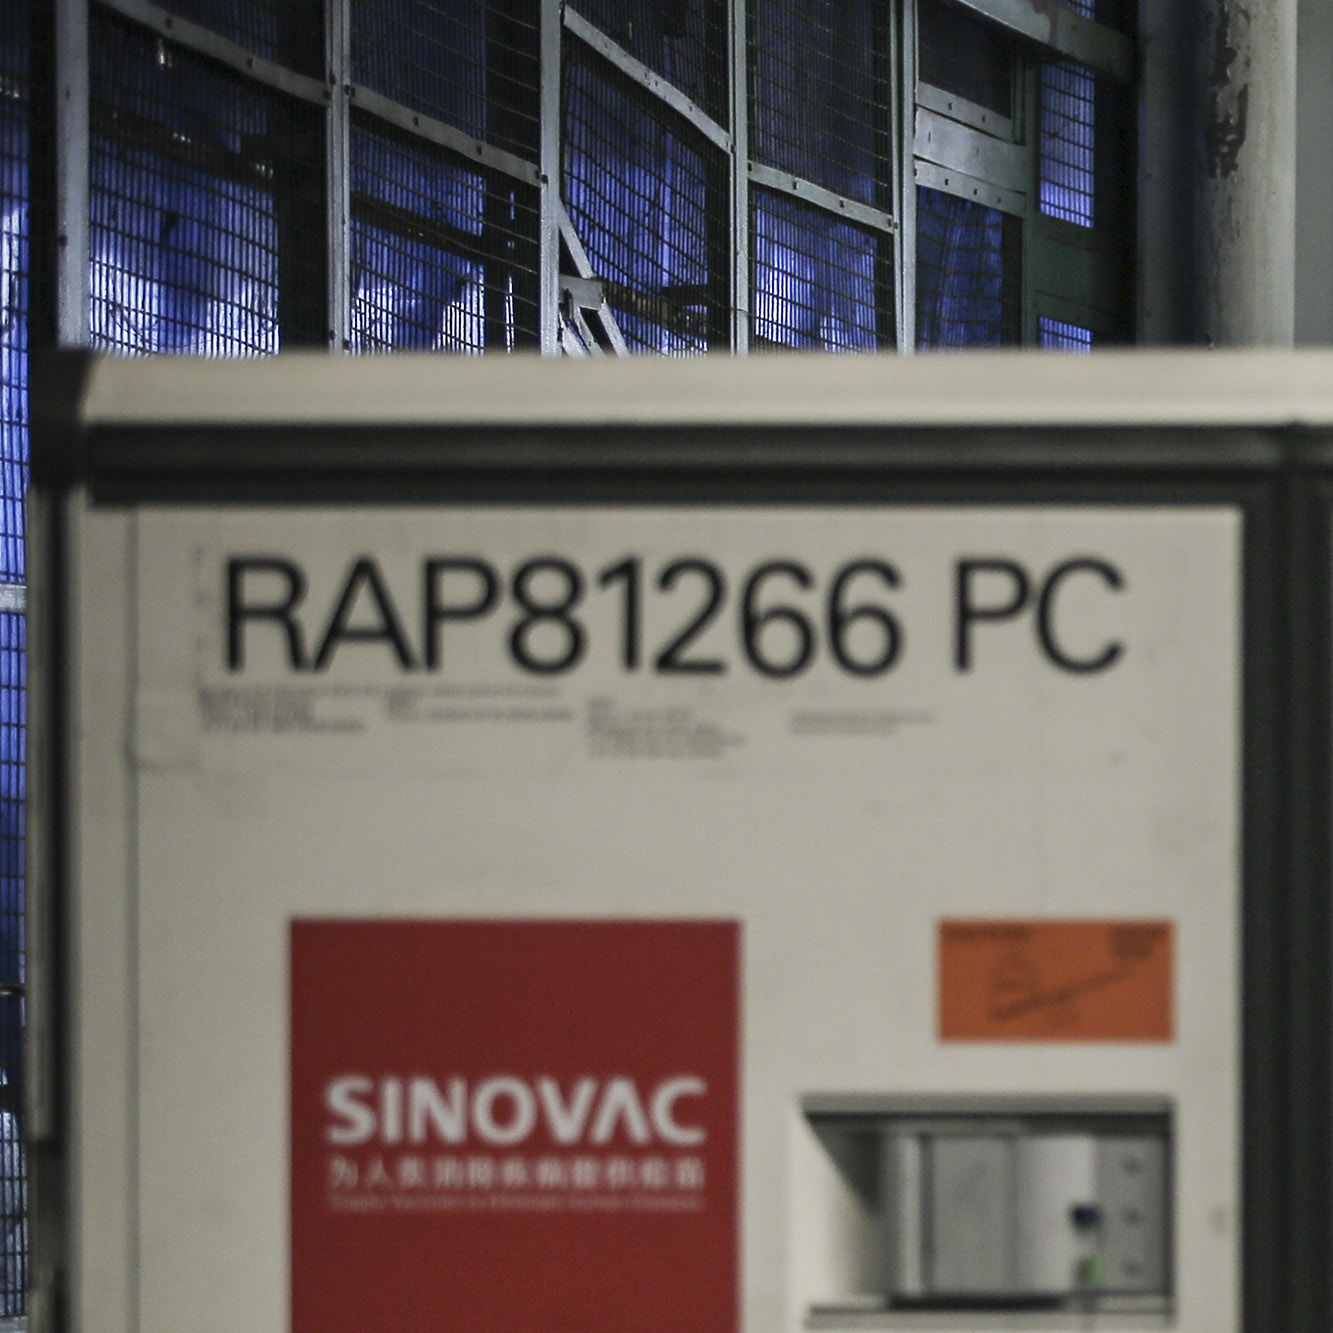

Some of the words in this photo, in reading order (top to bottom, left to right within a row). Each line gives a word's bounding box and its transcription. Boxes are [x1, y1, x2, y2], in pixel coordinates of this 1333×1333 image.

[222, 556, 905, 678] RAP81266
[951, 556, 1127, 677] PC
[326, 1075, 707, 1146] SINOVAC
